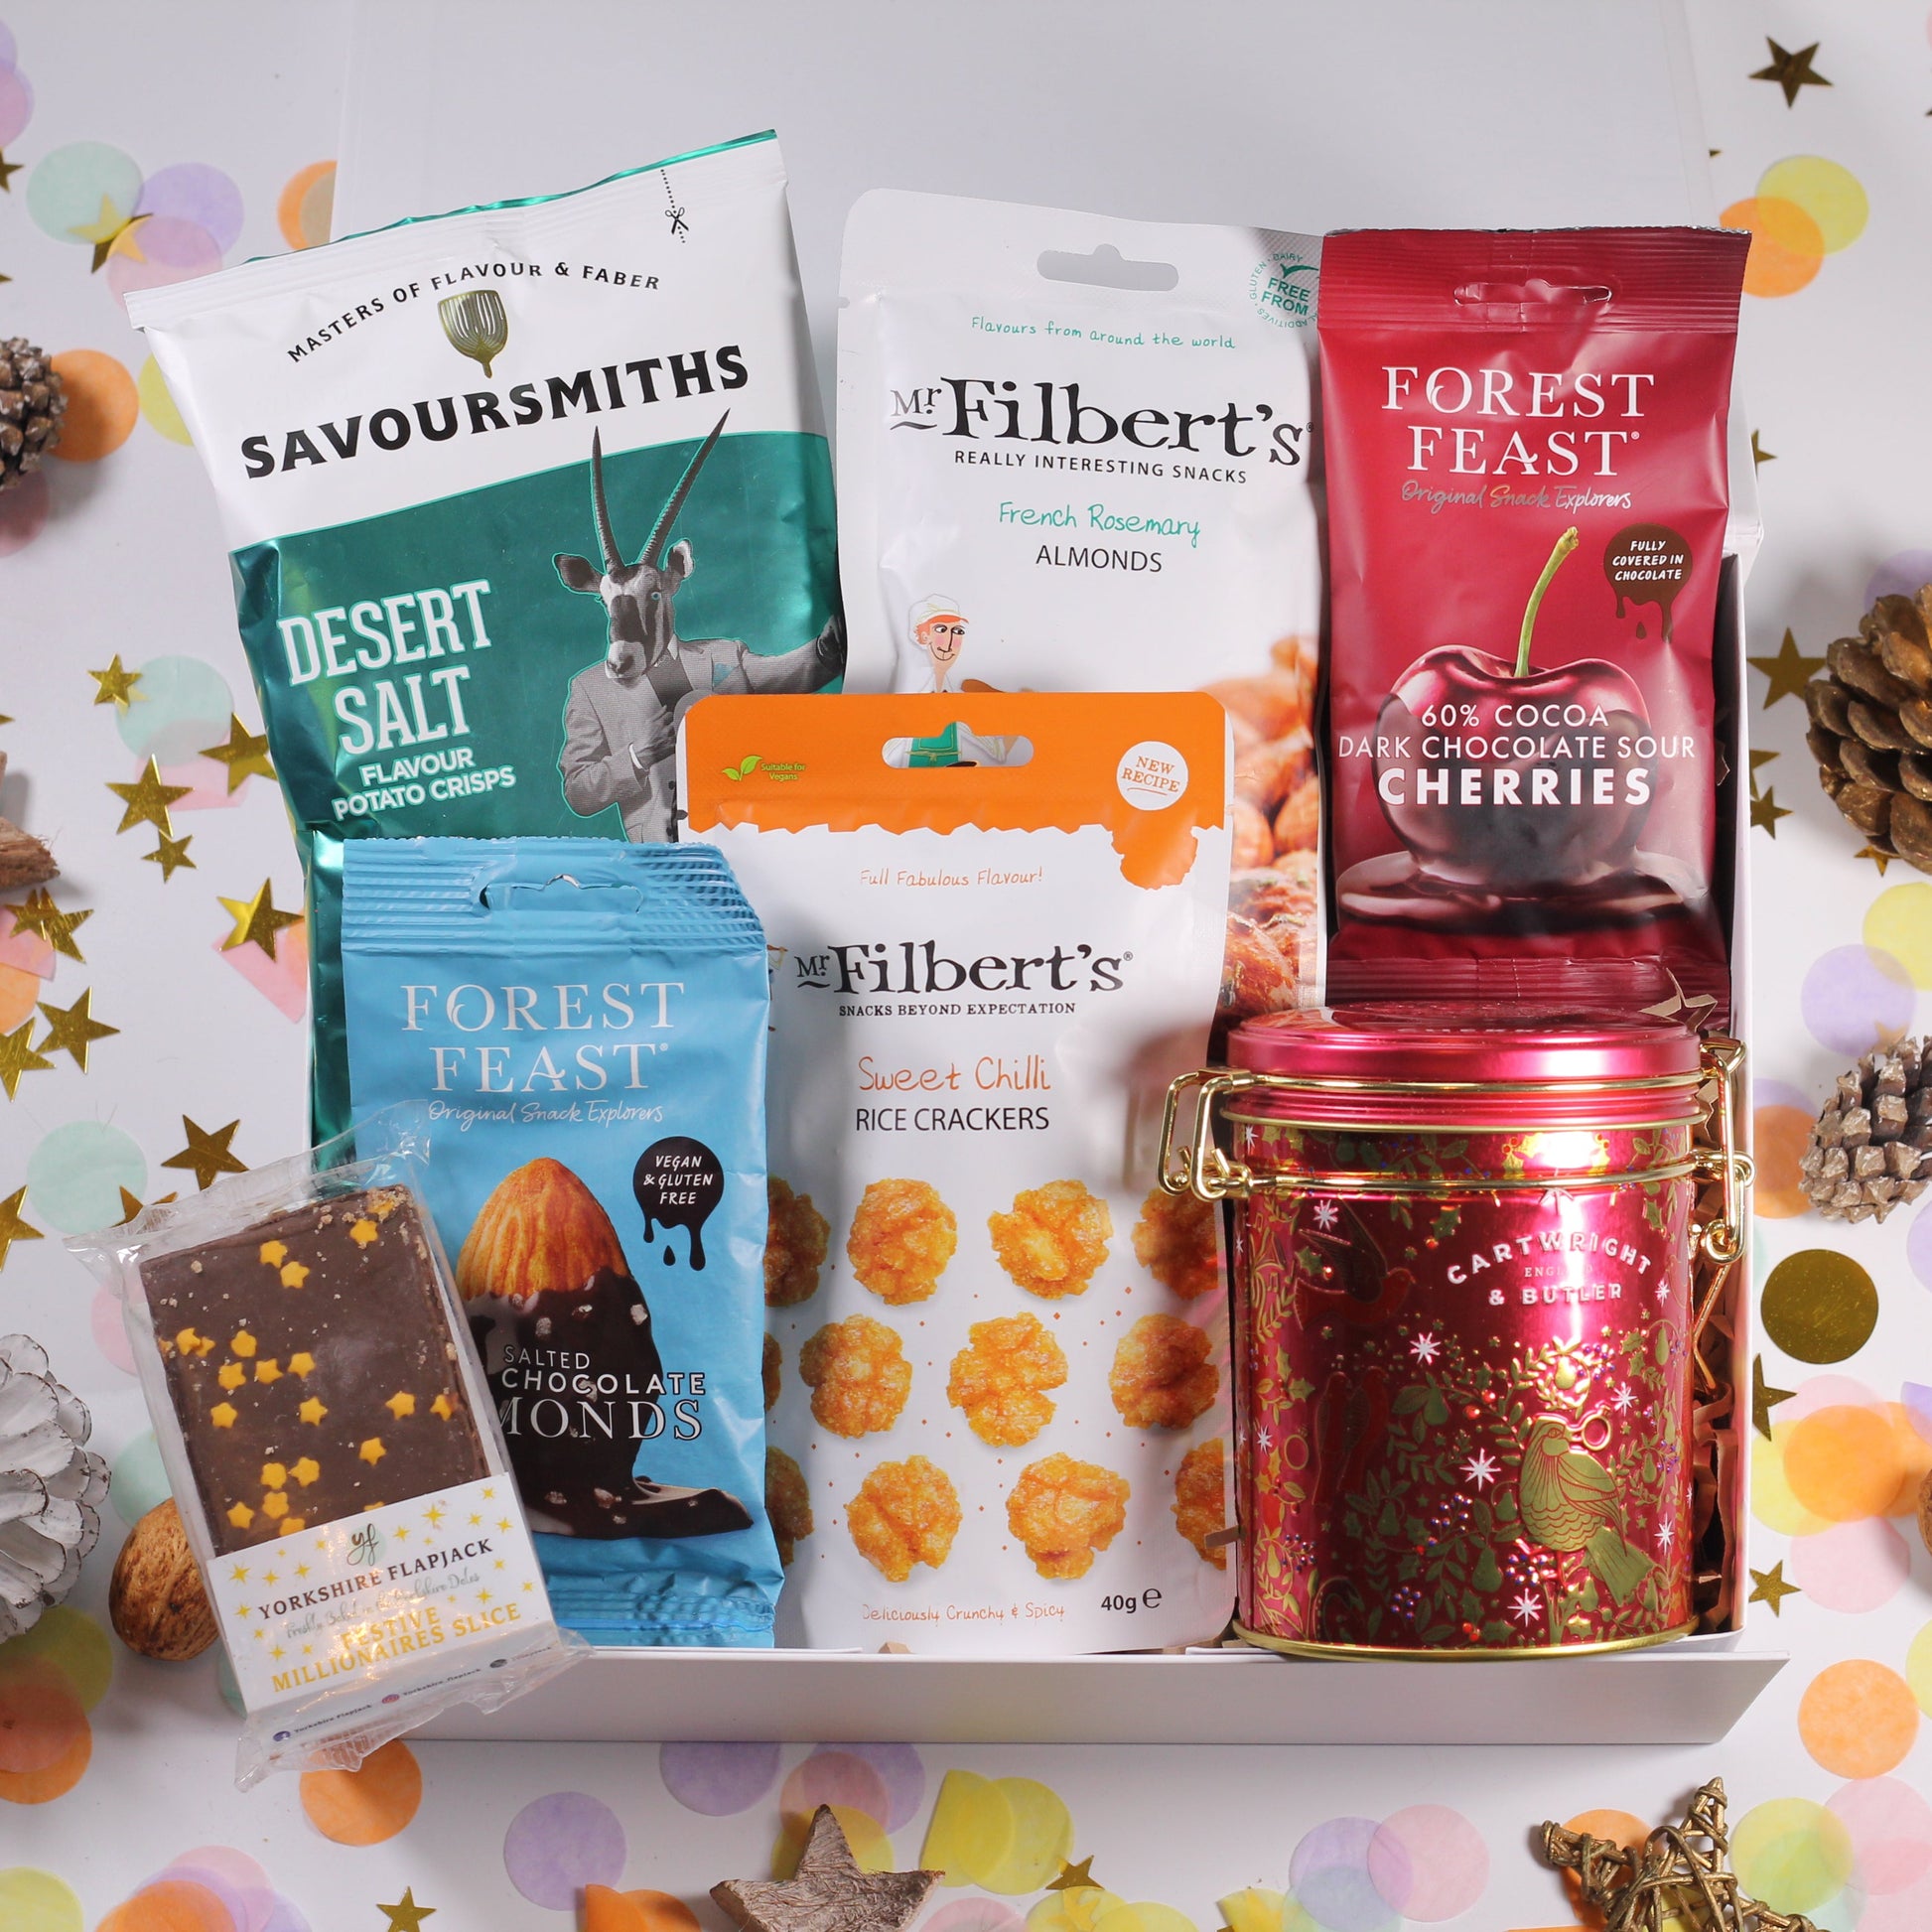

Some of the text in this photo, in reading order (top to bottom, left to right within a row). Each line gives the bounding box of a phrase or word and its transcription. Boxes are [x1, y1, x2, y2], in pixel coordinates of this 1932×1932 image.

[1261, 291, 1309, 316] FROM
[1268, 277, 1311, 303] FREE
[287, 261, 660, 362] MASTERS OF FLAVOUR & FABER
[972, 317, 1236, 348] Flavours from around the world
[1381, 366, 1654, 418] FOREST
[240, 345, 749, 479] SAVOURSMITHS
[954, 450, 1247, 484] REALLY INTERESTING SNACKS
[1402, 479, 1631, 514] Original Snack Explorers
[999, 500, 1200, 548] French Rosemary
[1035, 545, 1163, 573] ALMONDS
[1630, 540, 1666, 551] FULLY
[1612, 554, 1684, 566] COVERED IN
[1614, 569, 1683, 581] CHOCOLATE
[276, 578, 492, 687] DESERT
[333, 664, 471, 756] SALT
[1421, 703, 1609, 729] 60% COCOA
[1338, 735, 1696, 760] DARK CHOCOLATE SOUR
[359, 747, 476, 786] FLAVOUR
[760, 762, 806, 771] Suitable for
[768, 772, 798, 782] Vegans
[1136, 756, 1175, 774] NEW
[332, 764, 516, 821] POTATO CRISPS
[1121, 767, 1180, 793] RECIPE
[1377, 766, 1652, 807] CHERRIES
[860, 866, 1043, 887] Full Fabulous Flavour!
[401, 982, 685, 1033] FOREST
[839, 1002, 1076, 1017] SNACKS BEYOND EXPECTATION
[858, 1054, 1051, 1091] Sweet Chilli
[429, 1099, 663, 1132] Original Snack Explorers
[856, 1106, 1050, 1131] RICE CRACKERS
[655, 1155, 702, 1172] VEGAN
[642, 1173, 714, 1189] & GLUTEN
[659, 1191, 697, 1205] FREE
[1447, 1231, 1652, 1285] CARTWRIGHT
[1489, 1282, 1622, 1307] & BUTLER
[504, 1345, 590, 1370] SALTED
[501, 1367, 706, 1395] CHOCOLATE
[258, 1538, 493, 1620] YORKSHIRE FLAPJACK
[862, 1602, 940, 1627] Deliciously
[946, 1603, 1005, 1626] Crunchy
[1025, 1601, 1065, 1622] Spicy
[1100, 1594, 1138, 1614] 40g
[341, 1605, 442, 1650] FESTIVE
[271, 1602, 521, 1693] MILLIONAIRES SLICE
